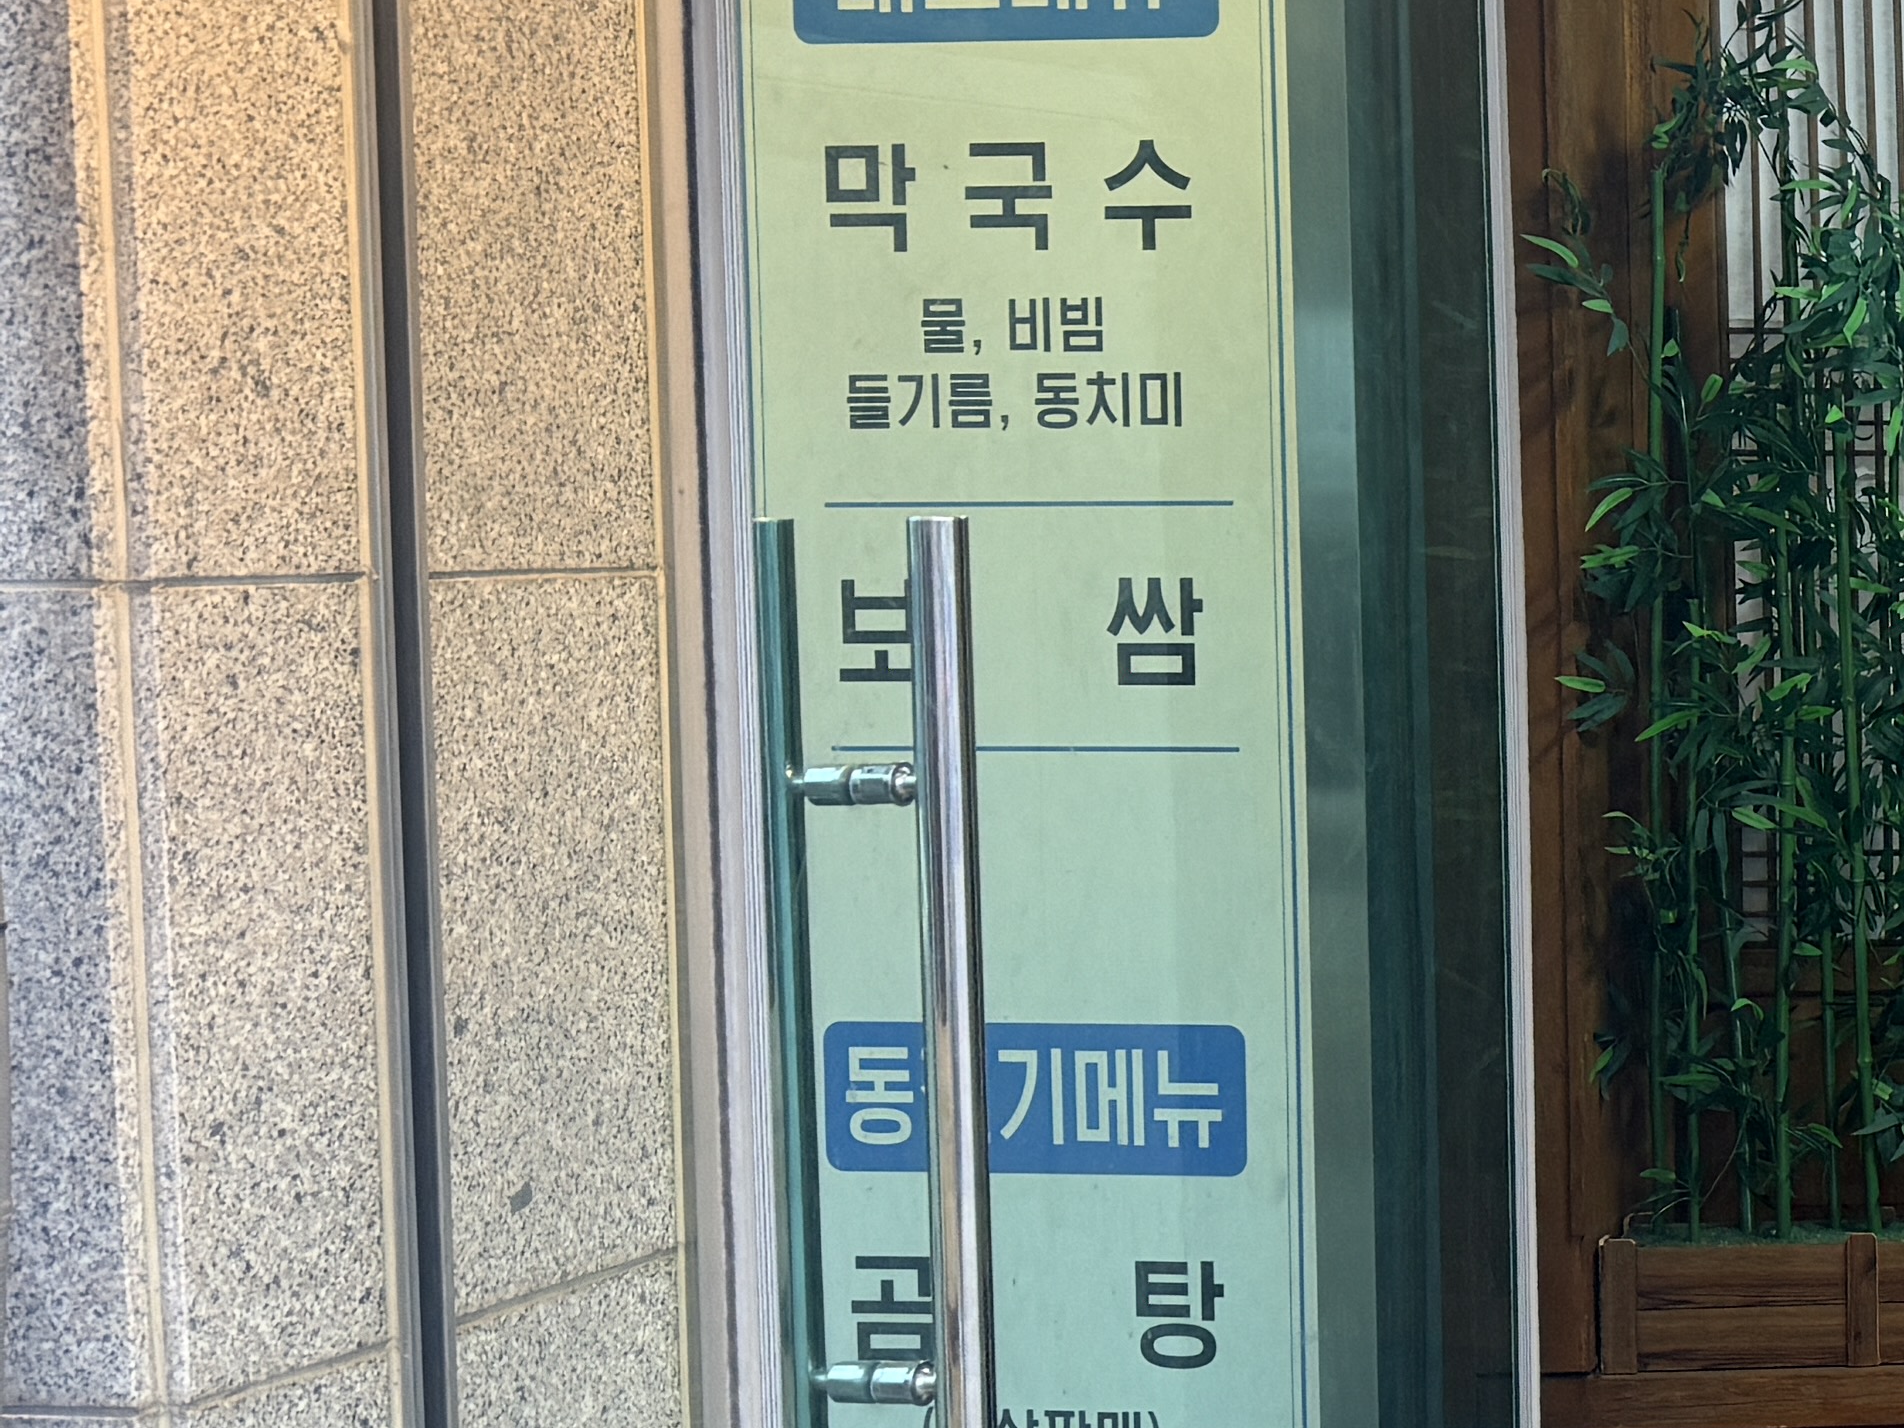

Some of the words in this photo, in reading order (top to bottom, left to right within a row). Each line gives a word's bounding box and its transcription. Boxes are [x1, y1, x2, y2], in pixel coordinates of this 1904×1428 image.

[920, 297, 983, 355] 물,
[1008, 296, 1104, 353] 비빔
[846, 373, 1010, 431] 들기름,
[1033, 371, 1184, 429] 동치미
[845, 1045, 1223, 1149] 동기메뉴
